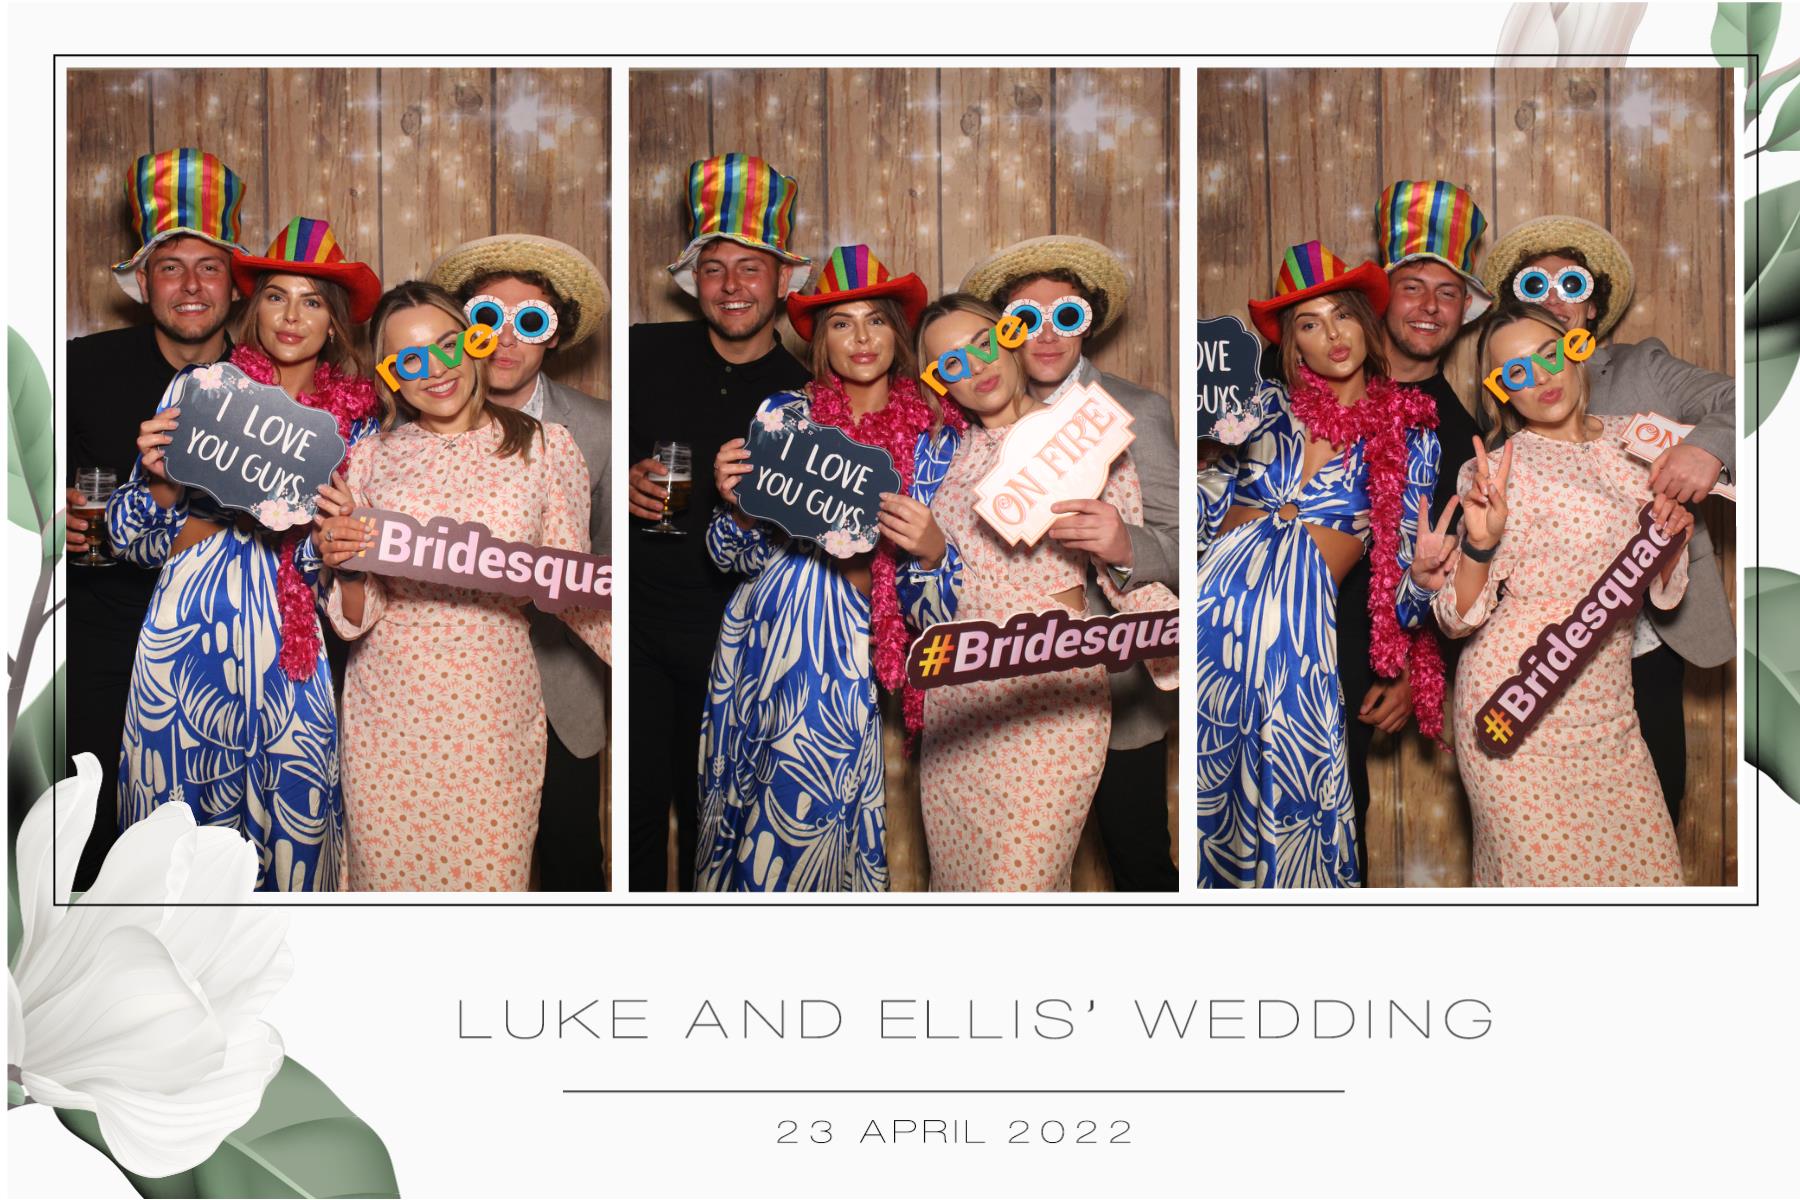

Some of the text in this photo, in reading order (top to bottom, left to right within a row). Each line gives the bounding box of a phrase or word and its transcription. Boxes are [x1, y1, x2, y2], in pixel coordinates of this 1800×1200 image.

[375, 323, 499, 393] rave
[920, 315, 1029, 397] rave
[1482, 327, 1597, 404] rave
[215, 391, 318, 462] I LOVE
[991, 397, 1118, 526] ON FIRE
[186, 426, 305, 505] YOU GUYS
[756, 465, 865, 535] YOU GUYS
[780, 432, 874, 496] I LOVE
